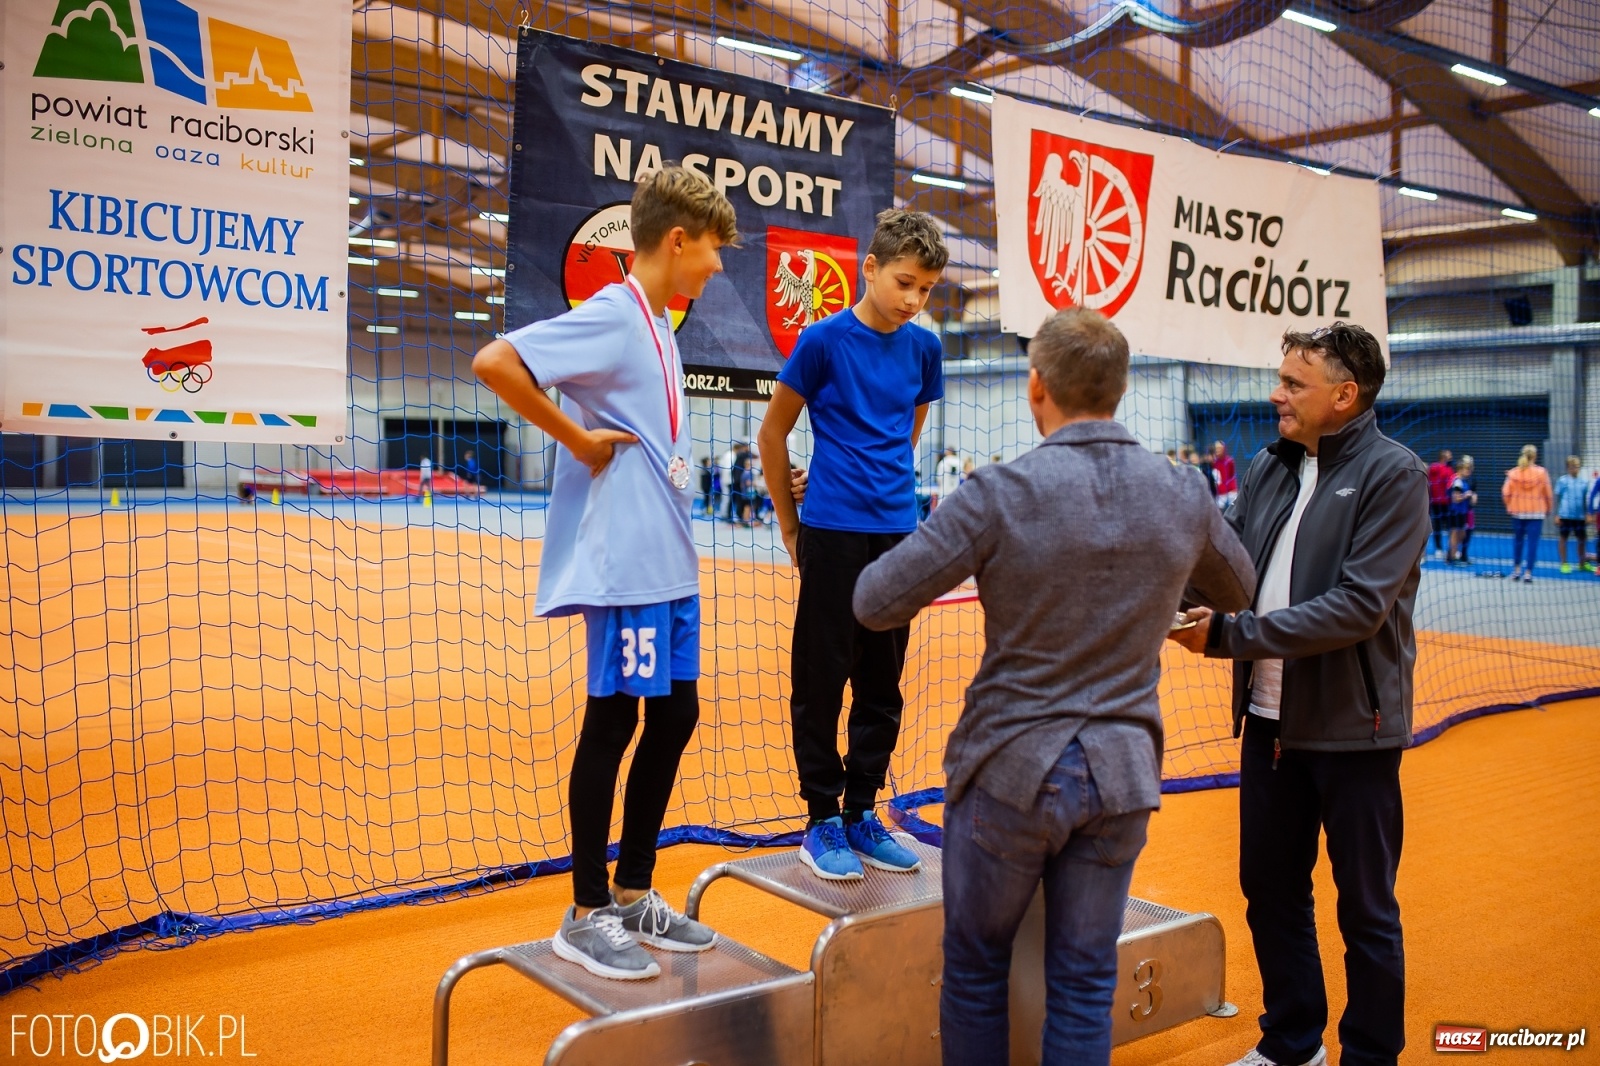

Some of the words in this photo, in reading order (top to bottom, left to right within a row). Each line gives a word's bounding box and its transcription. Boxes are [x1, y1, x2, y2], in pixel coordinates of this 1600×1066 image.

[31, 92, 148, 129] powiat
[170, 114, 314, 155] raciborski
[580, 63, 855, 157] STAWIAMY
[31, 123, 134, 155] zielona
[155, 145, 221, 167] oaza
[241, 153, 314, 179] kultur
[594, 133, 664, 184] NA
[681, 153, 842, 217] SPORT
[48, 189, 304, 256] KIBICUJEMY
[576, 219, 630, 263] VICTORIA
[1174, 196, 1284, 248] MIASTO
[12, 244, 330, 312] SPORTOWCOM
[1165, 240, 1351, 318] Racibórz
[1335, 487, 1357, 497] 4F
[621, 627, 657, 678] 35
[1130, 958, 1163, 1021] 3
